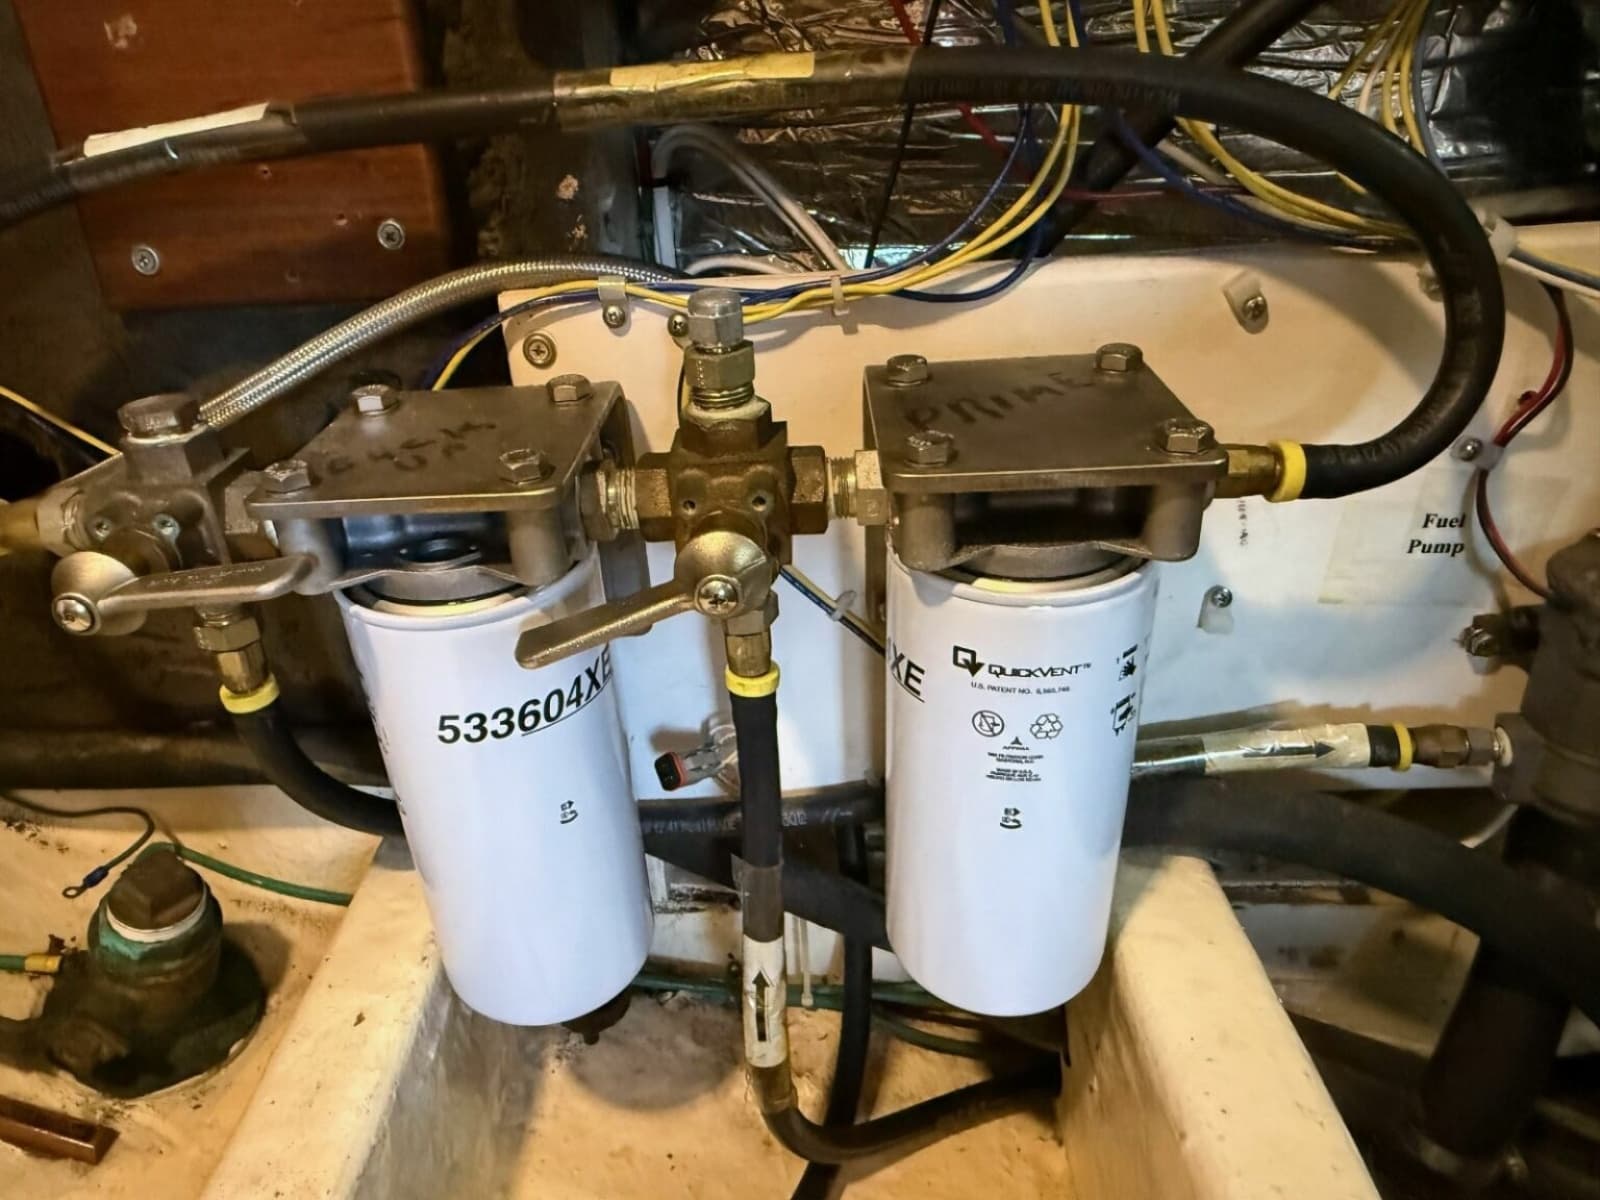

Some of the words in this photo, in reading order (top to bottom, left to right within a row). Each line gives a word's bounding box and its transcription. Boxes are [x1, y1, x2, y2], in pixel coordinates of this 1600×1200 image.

[1422, 512, 1466, 528] Fuel
[1407, 539, 1465, 557] Pump
[888, 641, 925, 697] XE
[987, 684, 1016, 694] PATENT
